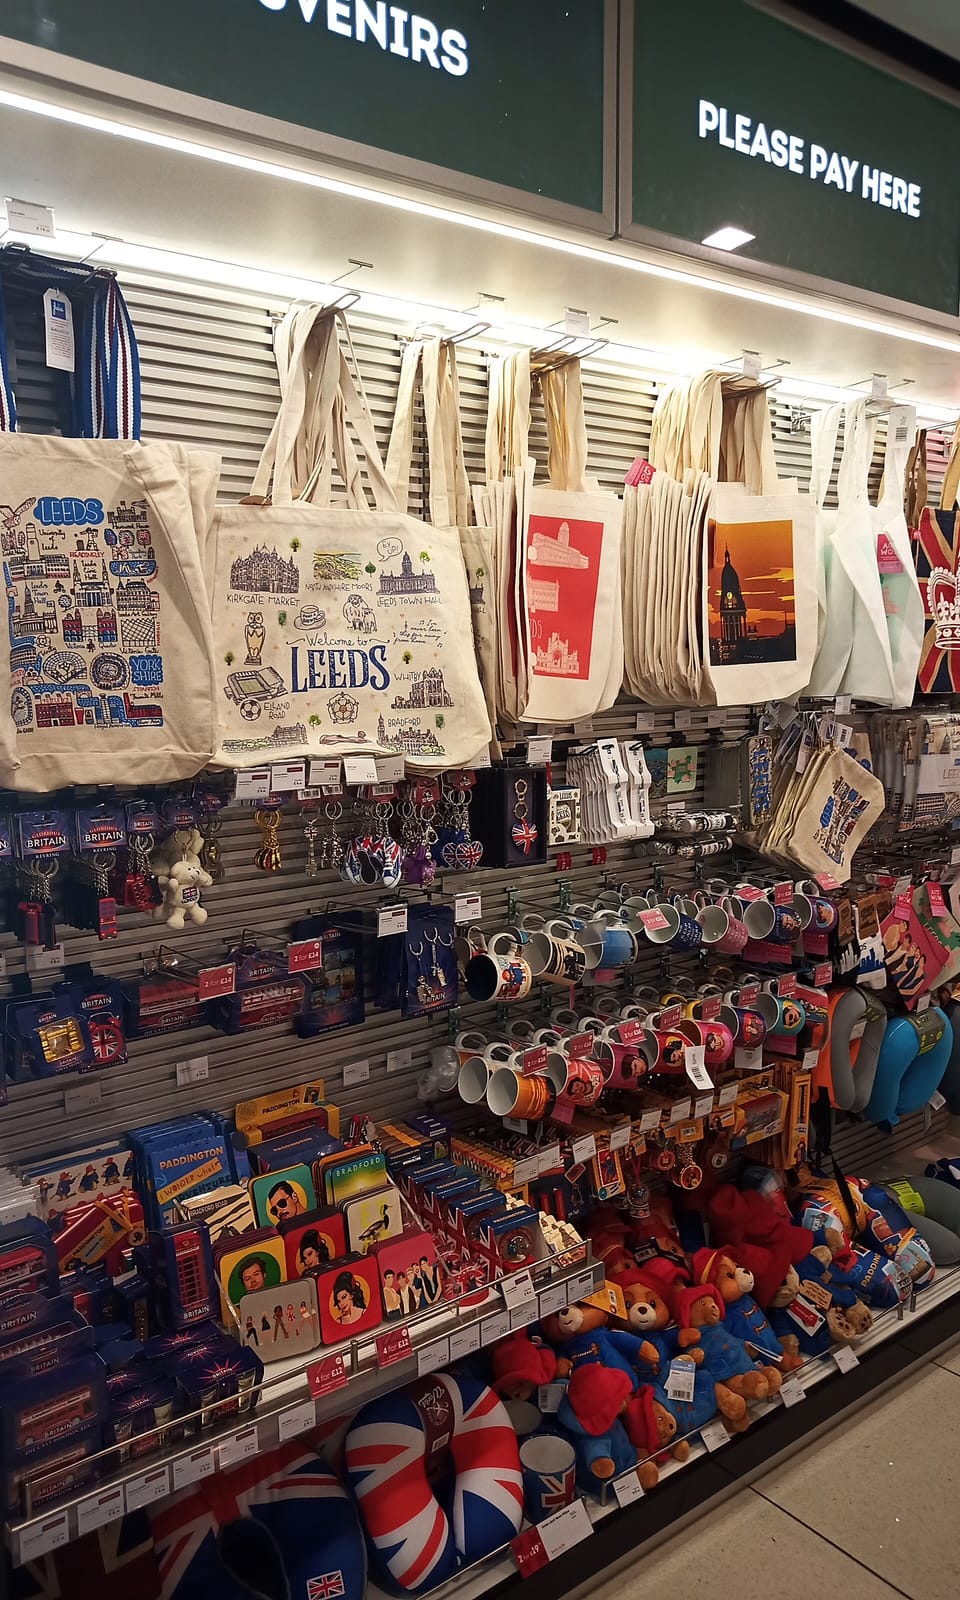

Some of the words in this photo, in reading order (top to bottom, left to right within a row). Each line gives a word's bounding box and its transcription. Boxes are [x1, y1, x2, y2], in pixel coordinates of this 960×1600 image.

[258, 0, 470, 77] VENIRS
[699, 100, 804, 174] PLEASE
[810, 144, 860, 192] PAY
[861, 168, 922, 218] HERE
[41, 500, 98, 523] LEEDS
[351, 583, 373, 592] MOORS
[226, 594, 264, 605] KIRKGATE
[268, 596, 300, 606] MARKET
[400, 597, 423, 605] TOWN
[306, 632, 354, 646] Welcome
[357, 636, 368, 646] to
[132, 659, 161, 671] YORK
[291, 645, 391, 692] LEEDS
[132, 671, 161, 682] SHIRE
[394, 672, 421, 682] WHITBY
[264, 702, 290, 711] ELLAND
[269, 711, 286, 720] ROAD
[388, 717, 421, 727] BRADFORD
[27, 835, 66, 848] BRITAIN
[32, 831, 61, 839] GLORIOUS
[85, 831, 124, 843] BRITAIN
[308, 951, 319, 959] £14
[249, 966, 275, 977] BRITAIN
[82, 997, 112, 1009] BRITAIN
[161, 1015, 185, 1024] BRITAIN
[263, 1098, 300, 1114] PADDINGTON
[160, 1146, 224, 1170] PADDINGTON
[335, 1156, 382, 1177] BRADFORD
[164, 1174, 195, 1196] WONDER
[197, 1164, 216, 1178] what
[190, 1203, 215, 1217] BRADFORD
[73, 1226, 105, 1256] PADDINGTON
[183, 1305, 210, 1319] BRITAIN
[1, 1311, 38, 1330] BRITAIN
[388, 1344, 397, 1353] for
[398, 1339, 409, 1349] £12
[31, 1357, 59, 1373] BRITAIN
[320, 1373, 330, 1382] for
[331, 1367, 343, 1377] £12
[44, 1422, 72, 1439] BRITAIN
[517, 1554, 523, 1563] 2
